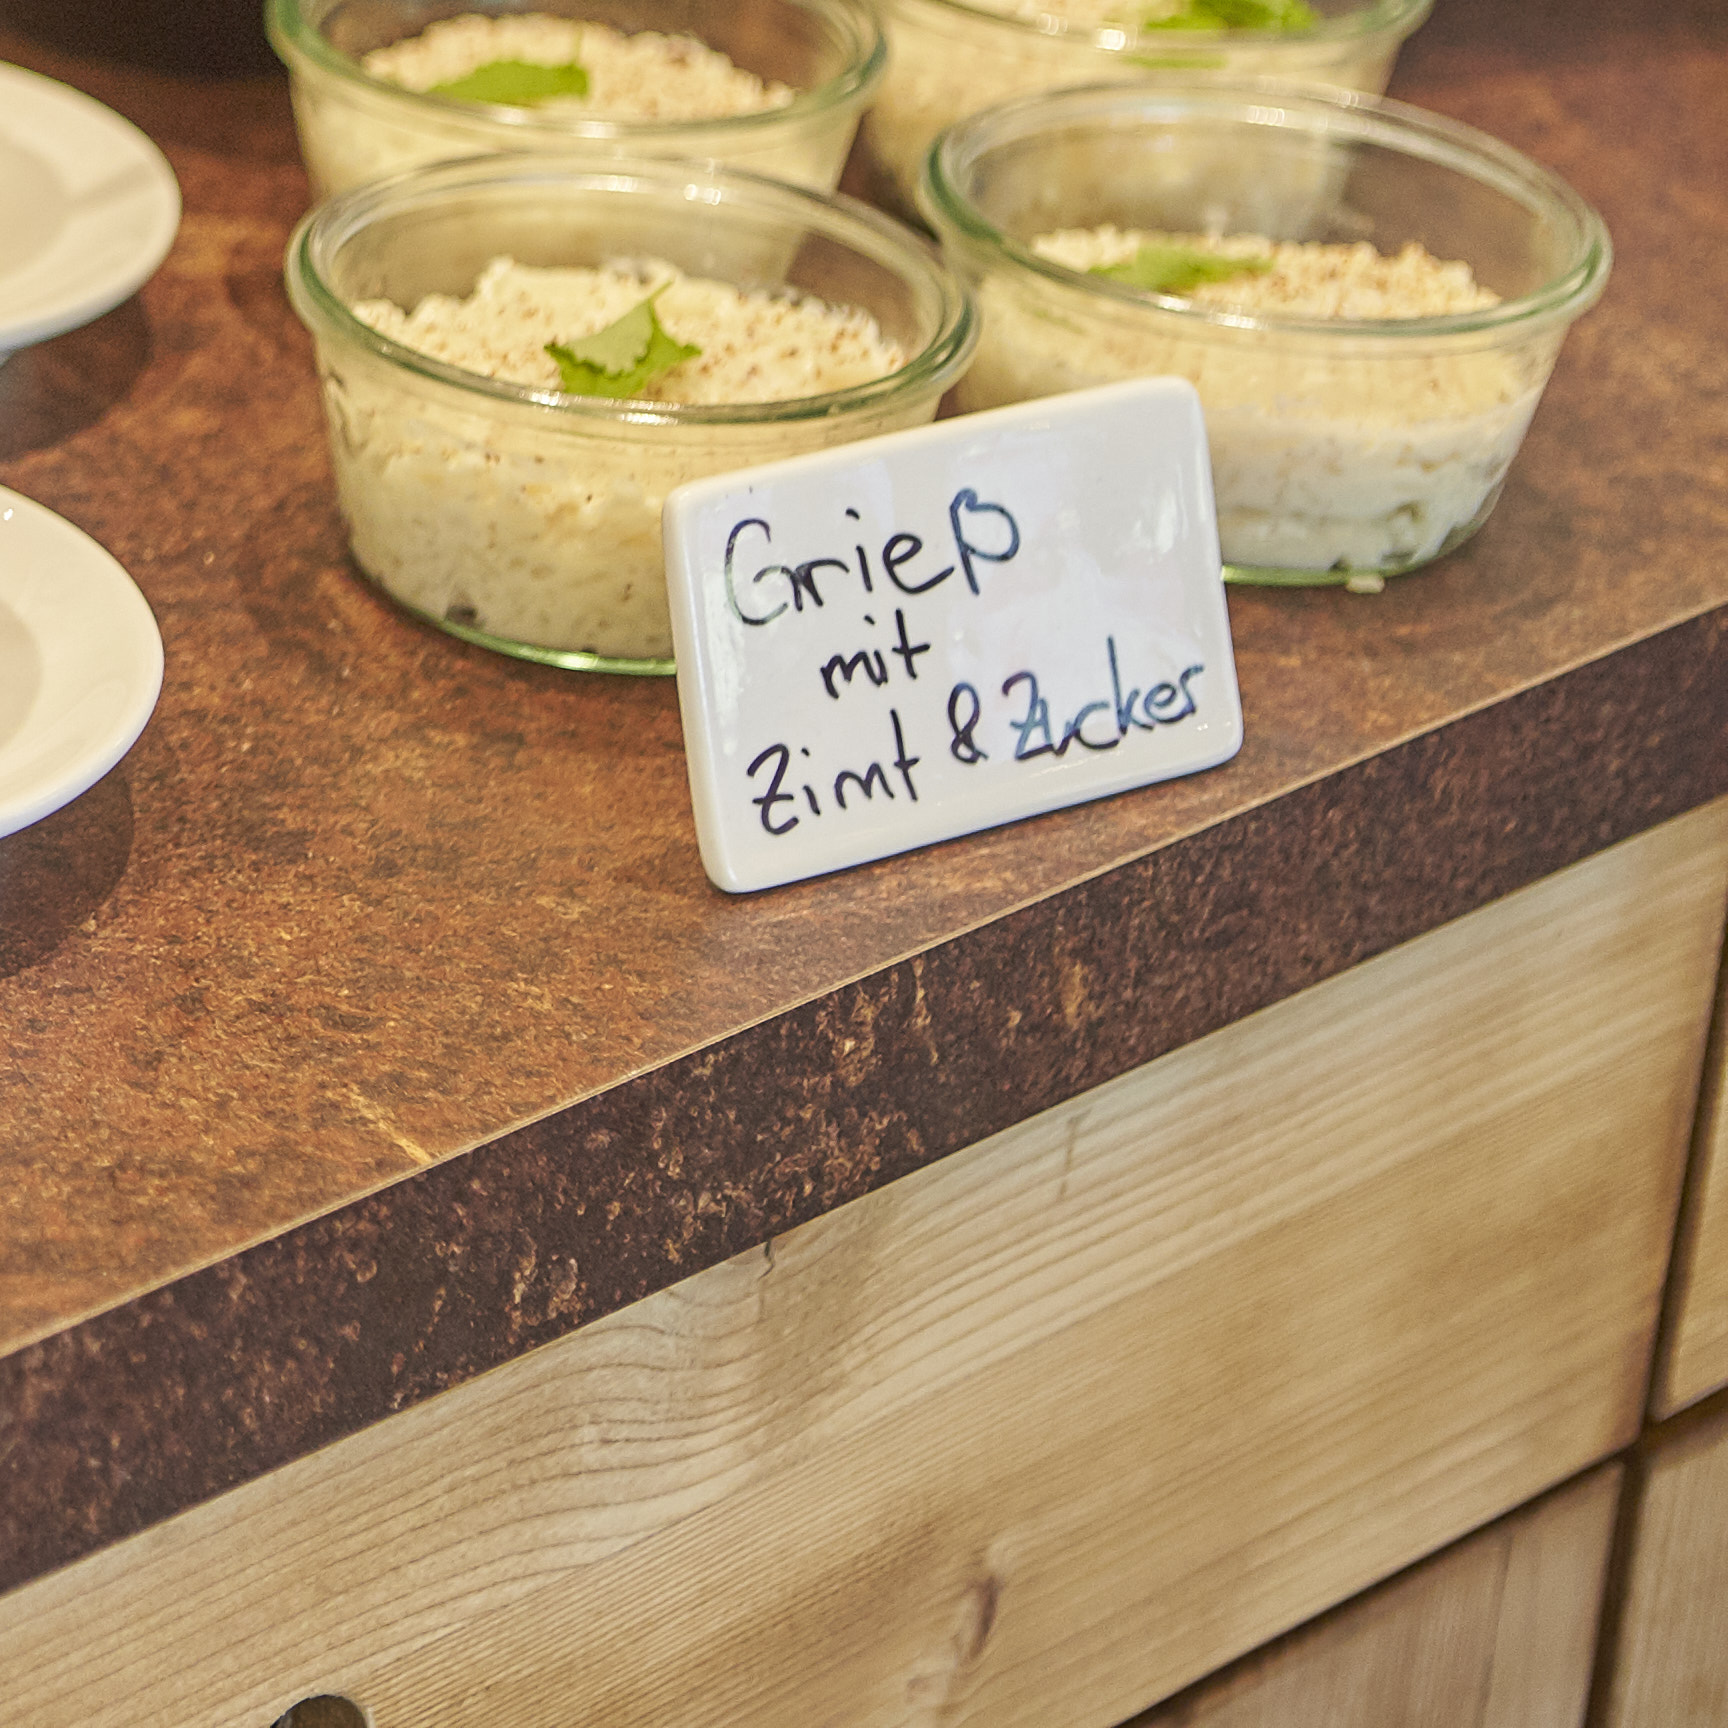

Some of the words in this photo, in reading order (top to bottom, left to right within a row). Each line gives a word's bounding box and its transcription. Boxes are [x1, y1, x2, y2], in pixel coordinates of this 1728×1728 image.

[820, 608, 932, 699] mit
[746, 709, 920, 836] Zimt
[947, 682, 989, 765] &
[1001, 635, 1205, 763] Zucker
